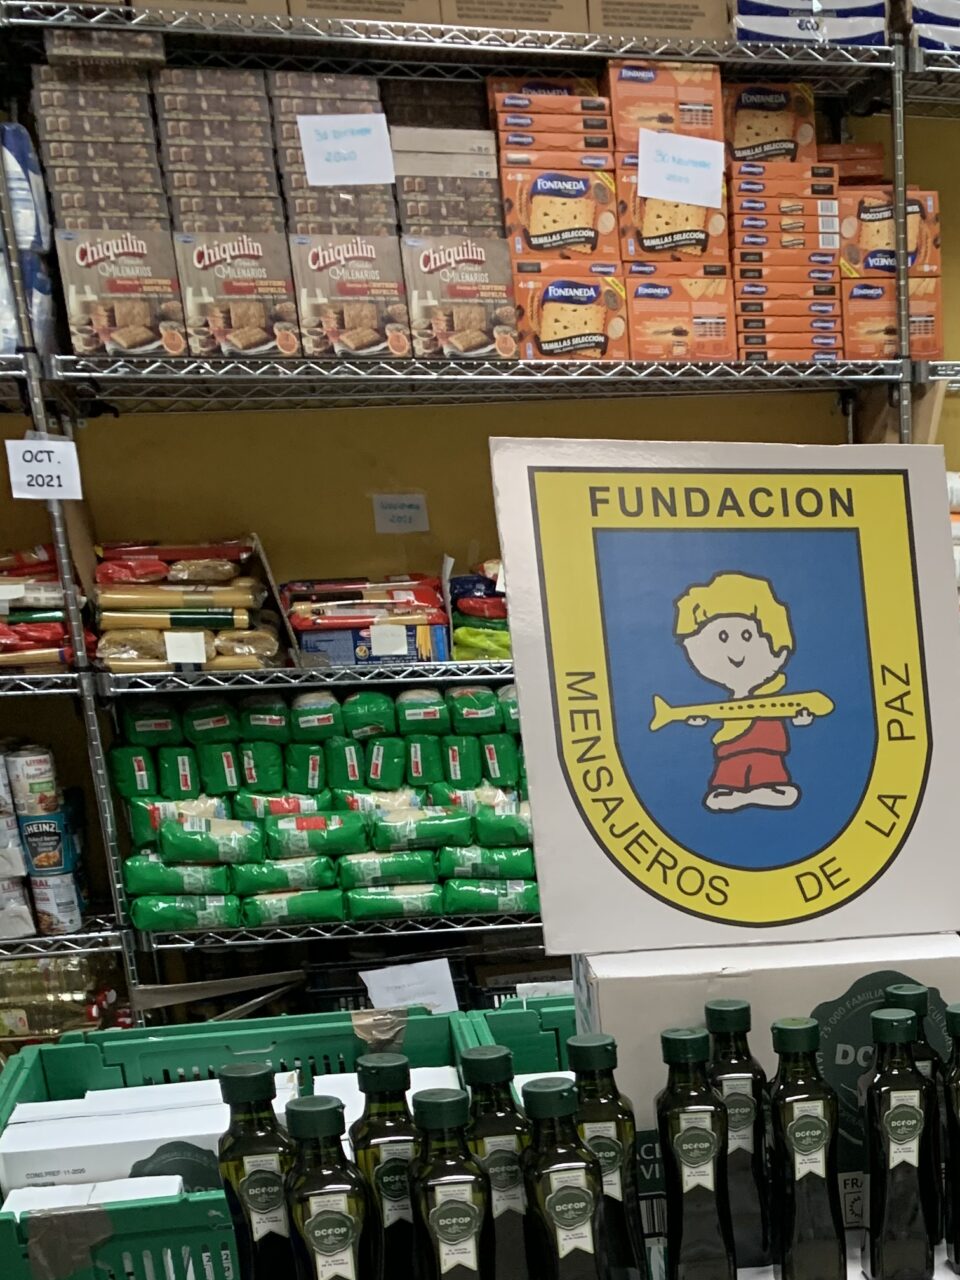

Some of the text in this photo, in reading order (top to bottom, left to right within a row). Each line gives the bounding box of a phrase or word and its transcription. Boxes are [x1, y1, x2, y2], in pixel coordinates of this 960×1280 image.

[537, 178, 585, 190] FONTANEDA
[549, 287, 595, 297] FONTANEDA
[23, 451, 61, 464] OCT.
[26, 474, 63, 487] 2021
[589, 486, 854, 518] FUNDACION
[564, 662, 916, 905] MENSAJEROS DE LA PAZ
[26, 823, 56, 833] HEINZ
